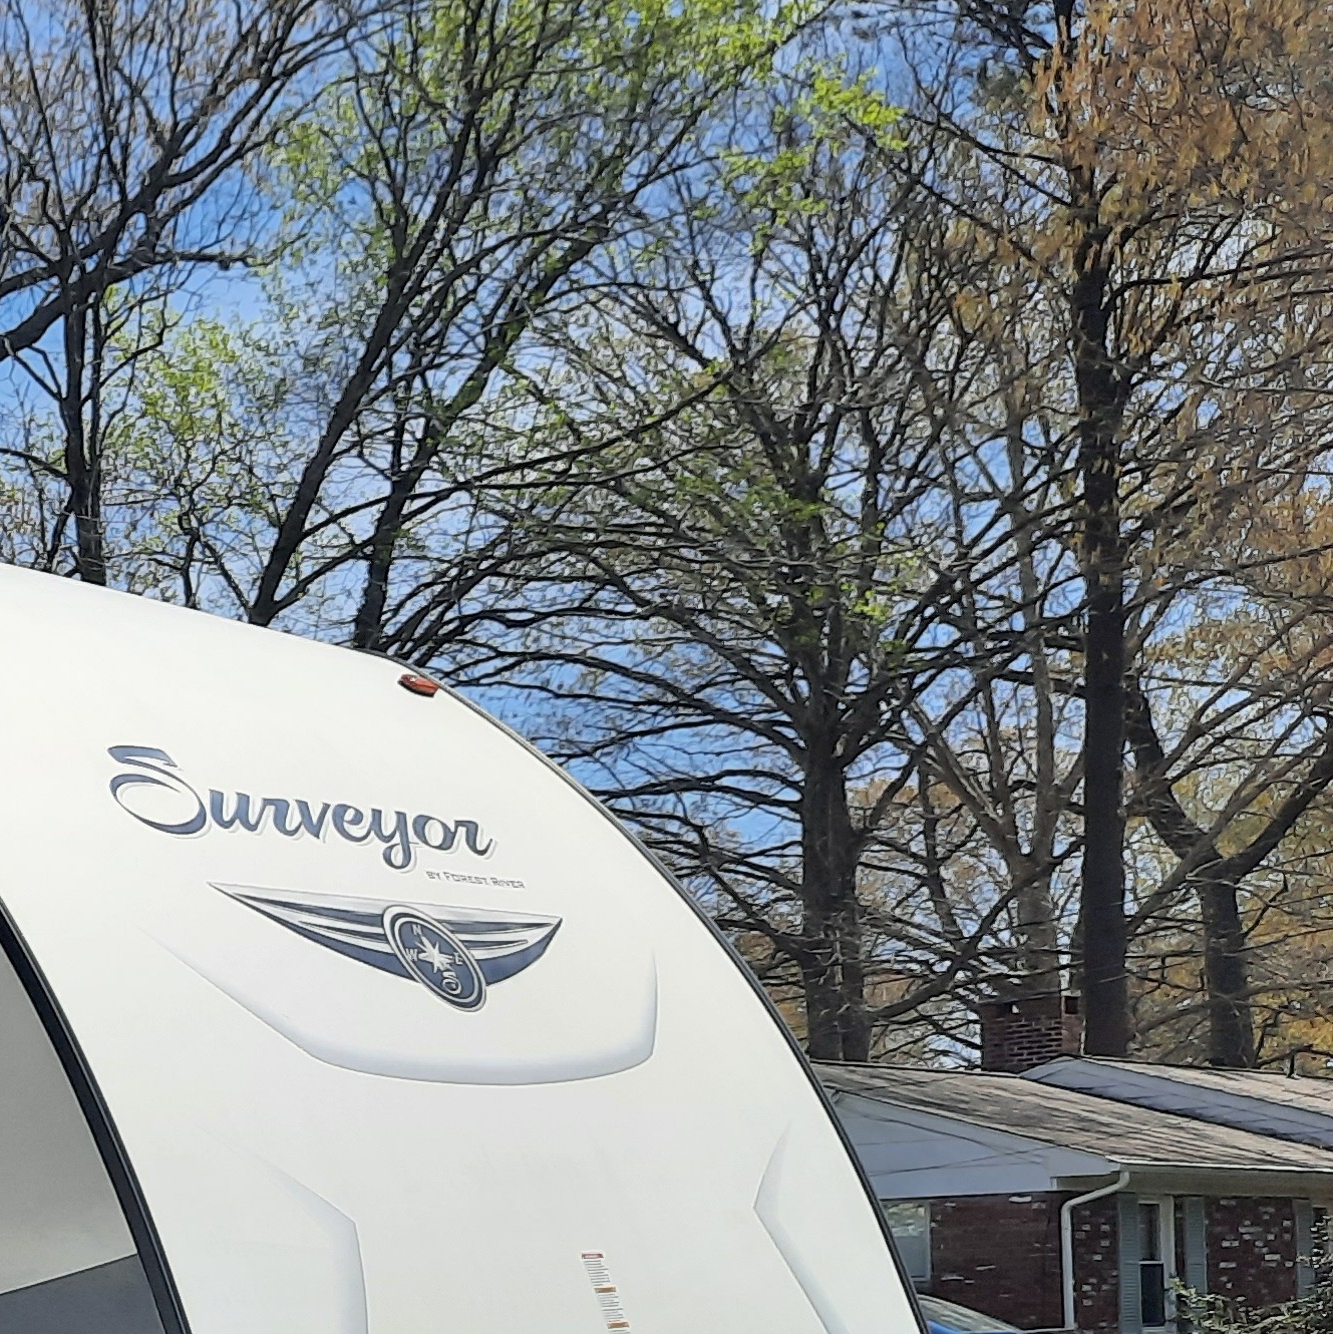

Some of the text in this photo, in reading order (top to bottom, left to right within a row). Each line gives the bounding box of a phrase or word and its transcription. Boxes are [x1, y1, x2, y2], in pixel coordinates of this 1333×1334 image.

[107, 745, 494, 870] Surveyor
[426, 871, 441, 880] BY
[443, 871, 489, 885] FOREST
[405, 948, 418, 961] W
